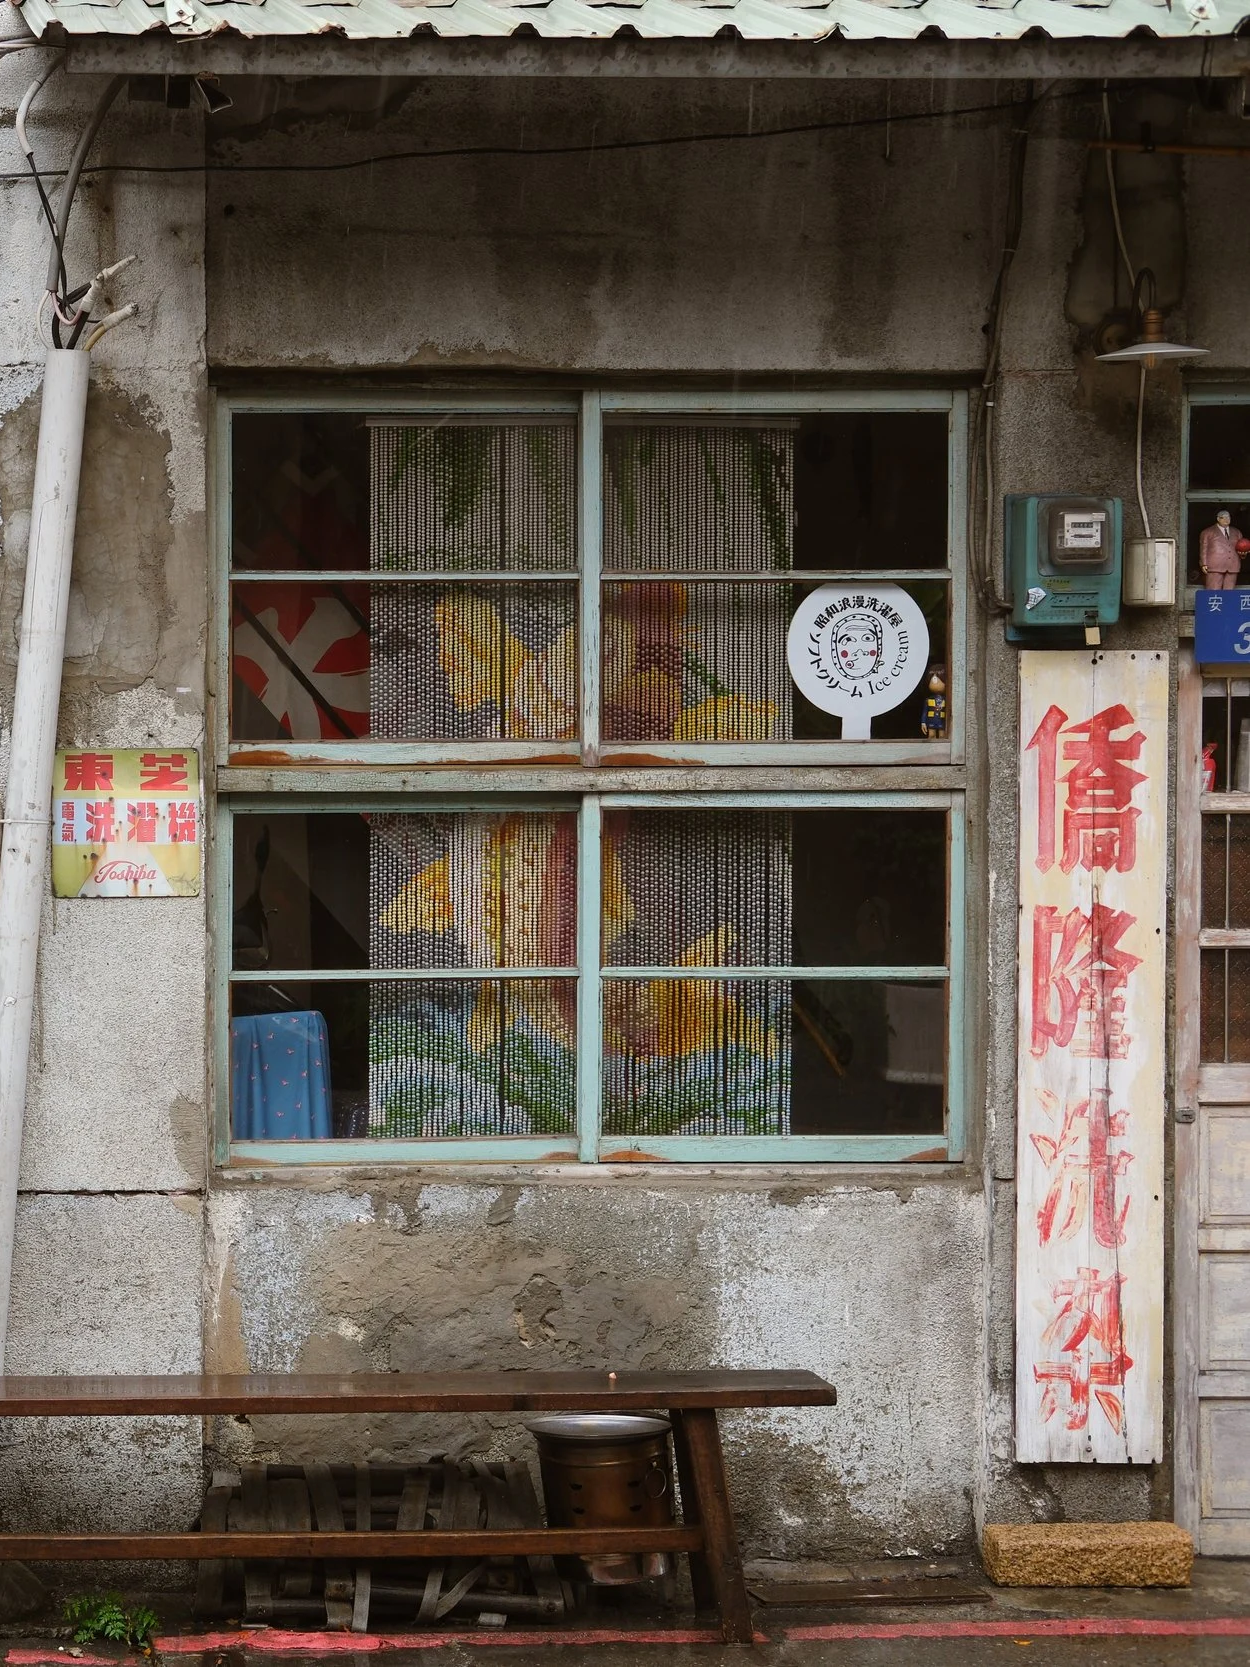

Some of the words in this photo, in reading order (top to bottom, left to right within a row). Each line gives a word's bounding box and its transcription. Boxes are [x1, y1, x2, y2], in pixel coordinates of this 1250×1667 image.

[814, 595, 903, 630] 昭和浪漫洗濯屋
[868, 676, 891, 695] Ice
[890, 630, 909, 677] cream
[64, 753, 188, 791] 東芝
[94, 860, 157, 884] Toshiba
